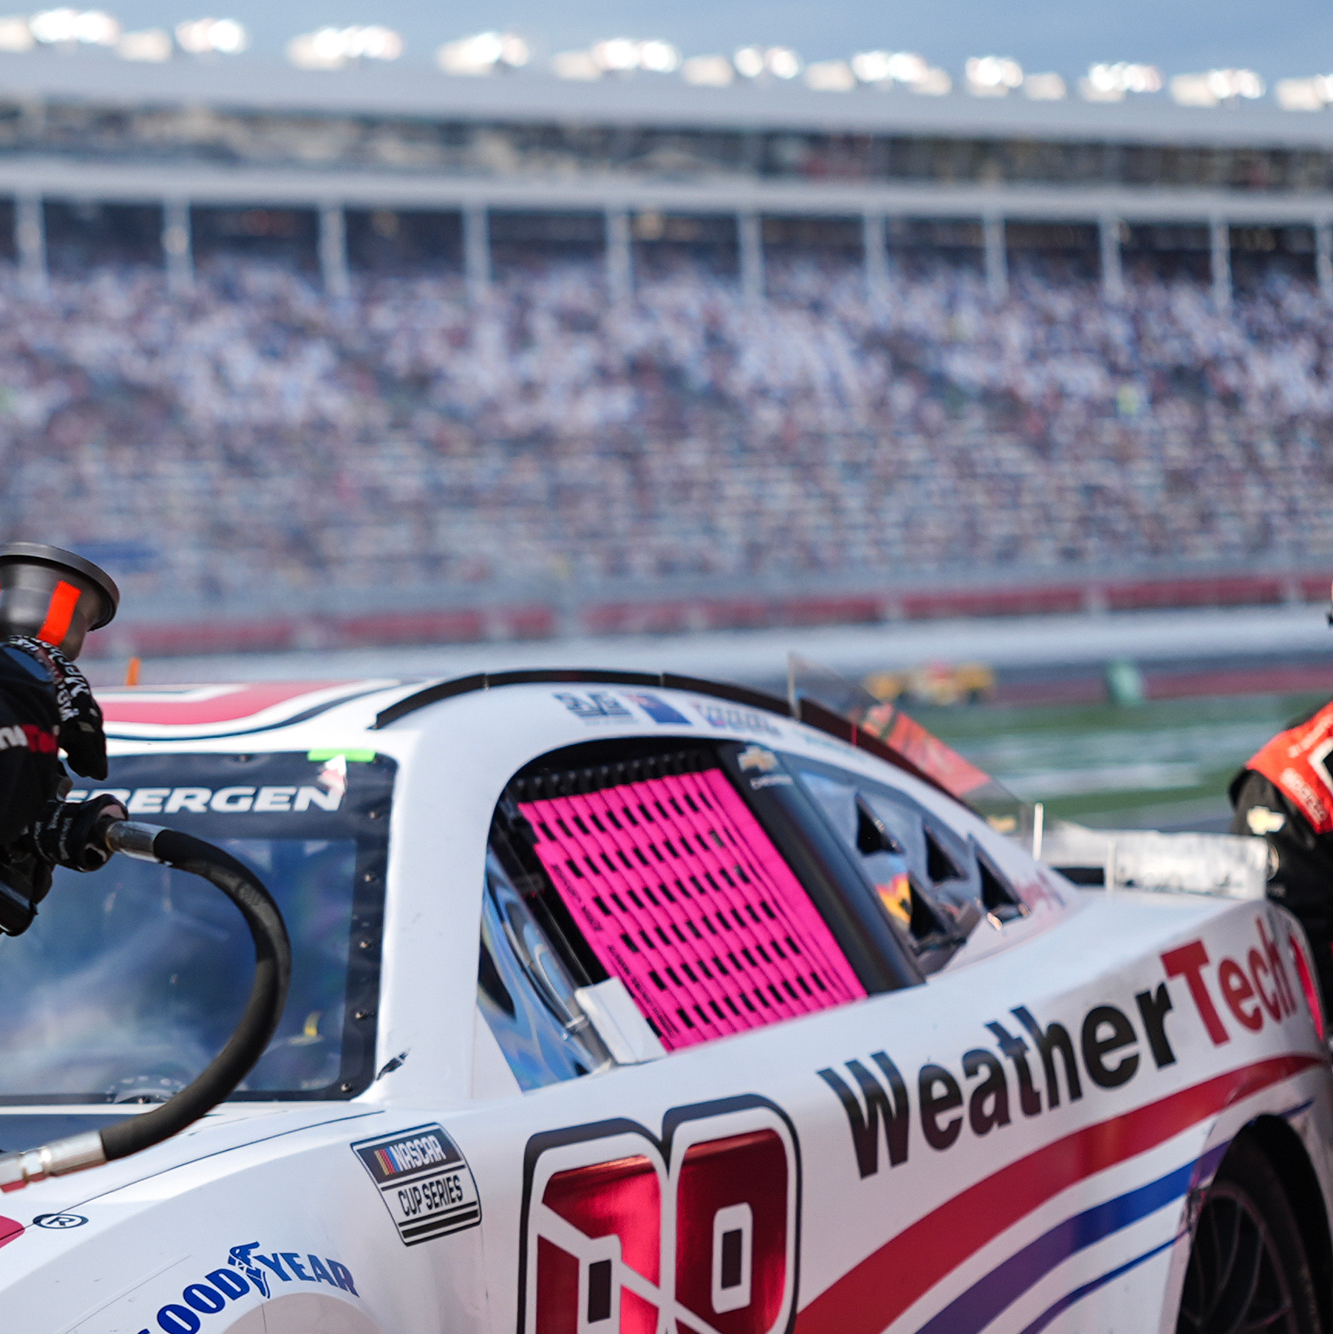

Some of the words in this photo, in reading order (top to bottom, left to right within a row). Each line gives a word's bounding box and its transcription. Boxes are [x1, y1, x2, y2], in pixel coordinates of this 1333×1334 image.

[817, 915, 1299, 1180] WeatherTech
[389, 1133, 448, 1172] NASCAR
[398, 1186, 422, 1217] CUP
[421, 1174, 464, 1211] SERIES
